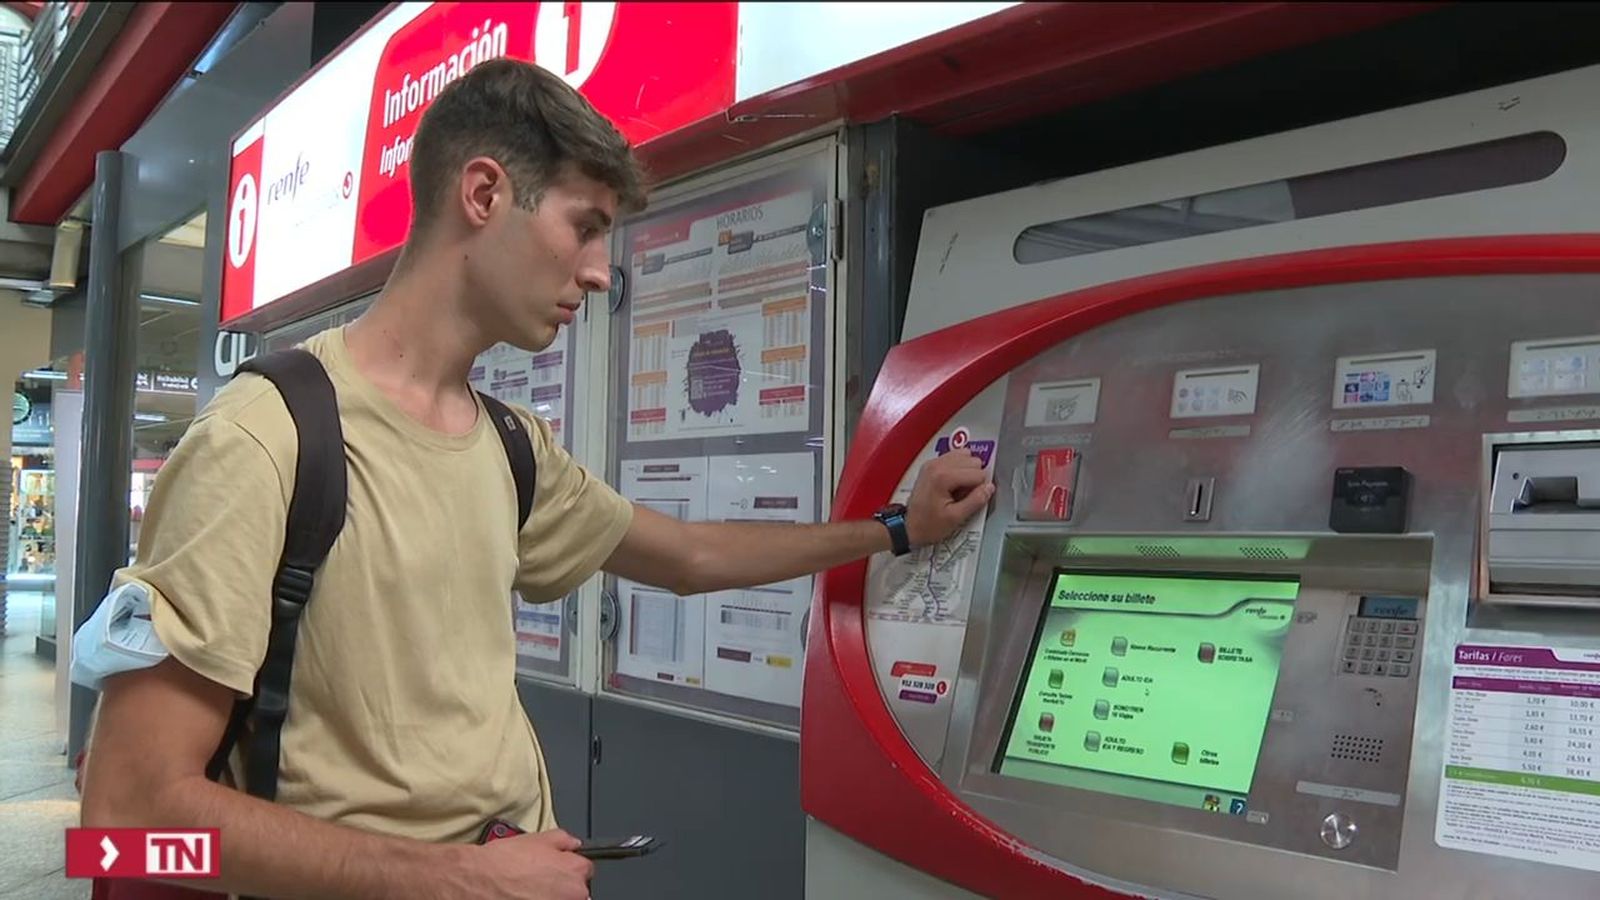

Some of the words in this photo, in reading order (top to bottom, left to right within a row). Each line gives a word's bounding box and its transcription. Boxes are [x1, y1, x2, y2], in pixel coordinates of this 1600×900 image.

[383, 19, 508, 128] Información
[267, 151, 310, 205] renfe
[716, 205, 764, 231] HORARIOS
[1058, 590, 1109, 602] Seleccione
[1110, 594, 1124, 602] su
[1125, 593, 1156, 604] billete
[1459, 651, 1489, 660] Tarifas
[1499, 652, 1522, 662] Fares
[1200, 749, 1218, 757] Otros
